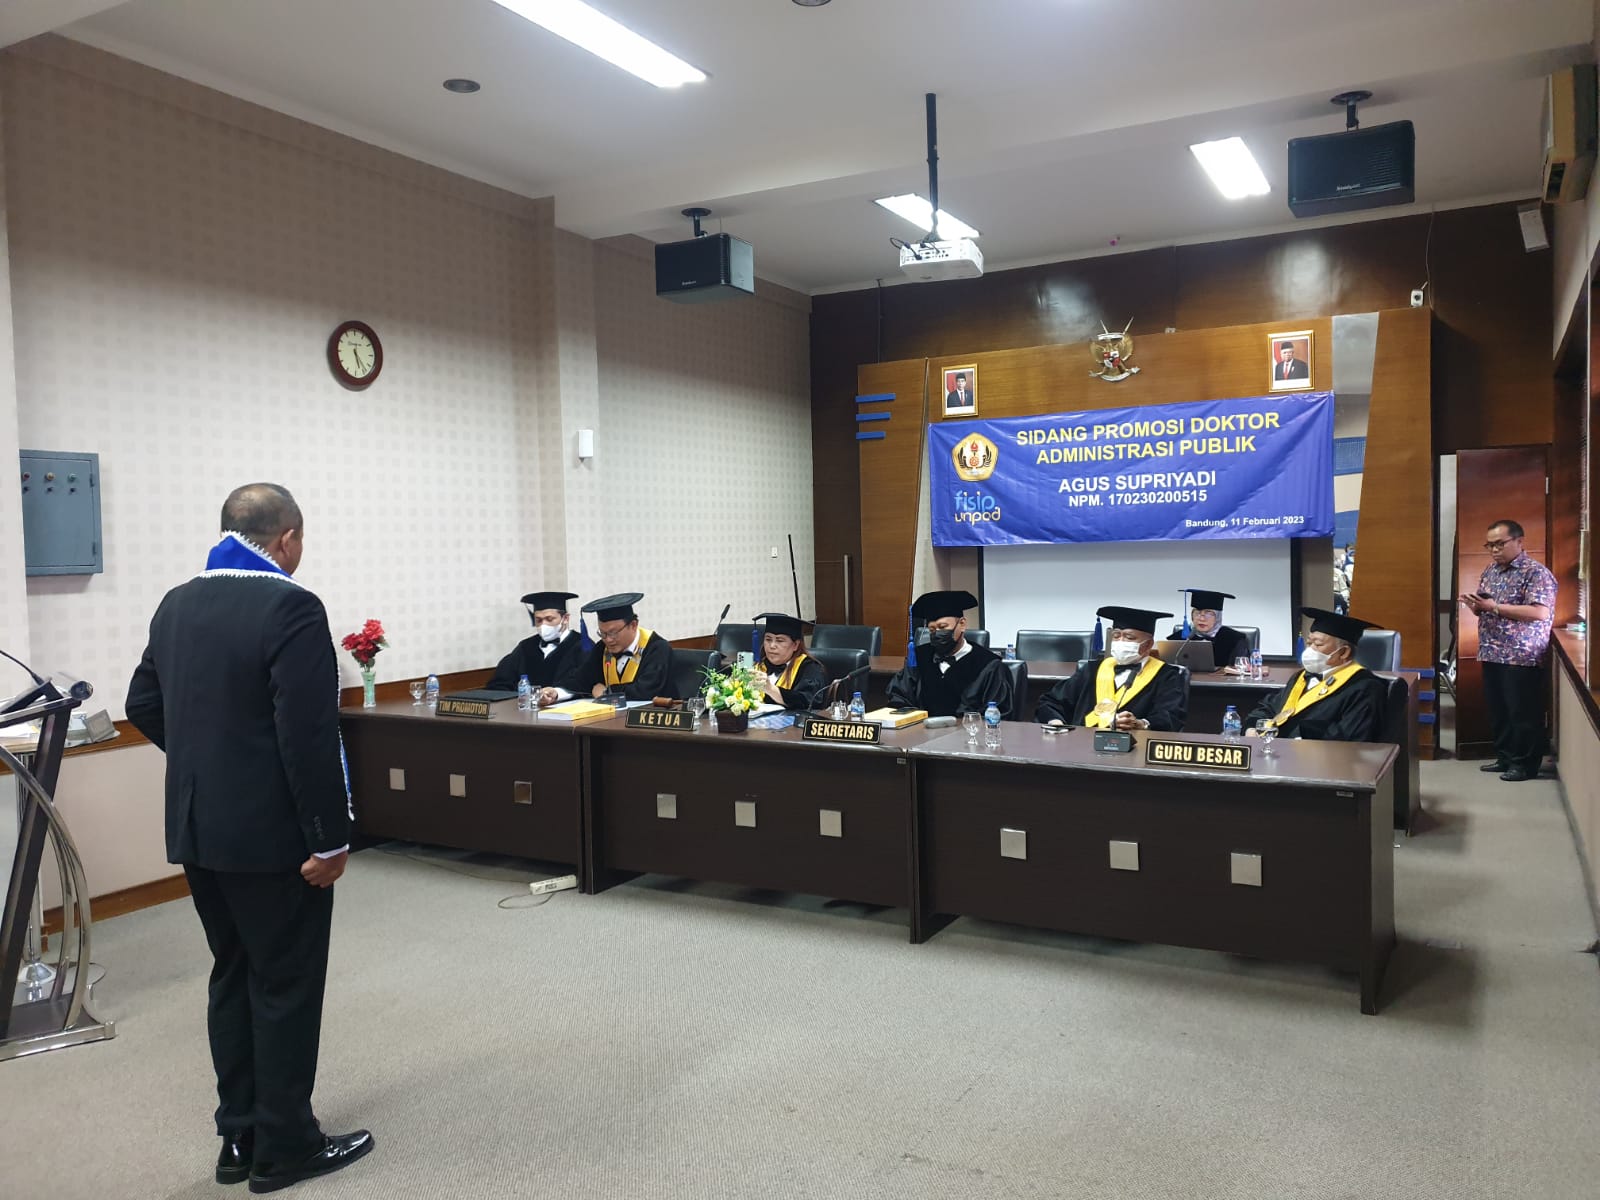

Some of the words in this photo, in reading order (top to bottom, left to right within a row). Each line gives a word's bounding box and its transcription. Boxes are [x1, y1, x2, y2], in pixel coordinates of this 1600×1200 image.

[1016, 426, 1088, 446] SIDANG
[1093, 418, 1185, 441] PROMOSI
[1190, 412, 1281, 434] DOKTOR
[1036, 441, 1174, 465] ADMINISTRASI
[1180, 435, 1257, 456] PUBLIK
[1058, 476, 1110, 493] AGUS
[1115, 470, 1216, 491] SUPRIYADI
[953, 490, 996, 513] fisip
[1068, 494, 1104, 507] NPM.
[1108, 489, 1207, 506] 170230200515
[954, 506, 1001, 528] unpad
[1185, 519, 1229, 528] Bandung,
[1231, 517, 1241, 526] 11
[1243, 516, 1281, 526] Februari
[1282, 515, 1305, 525] 2023
[451, 701, 488, 715] PROMOTOR
[639, 711, 681, 727] KETUA
[810, 722, 875, 740] SEKRETARIS
[1154, 744, 1193, 762] GURU
[1196, 746, 1243, 766] BESAR
